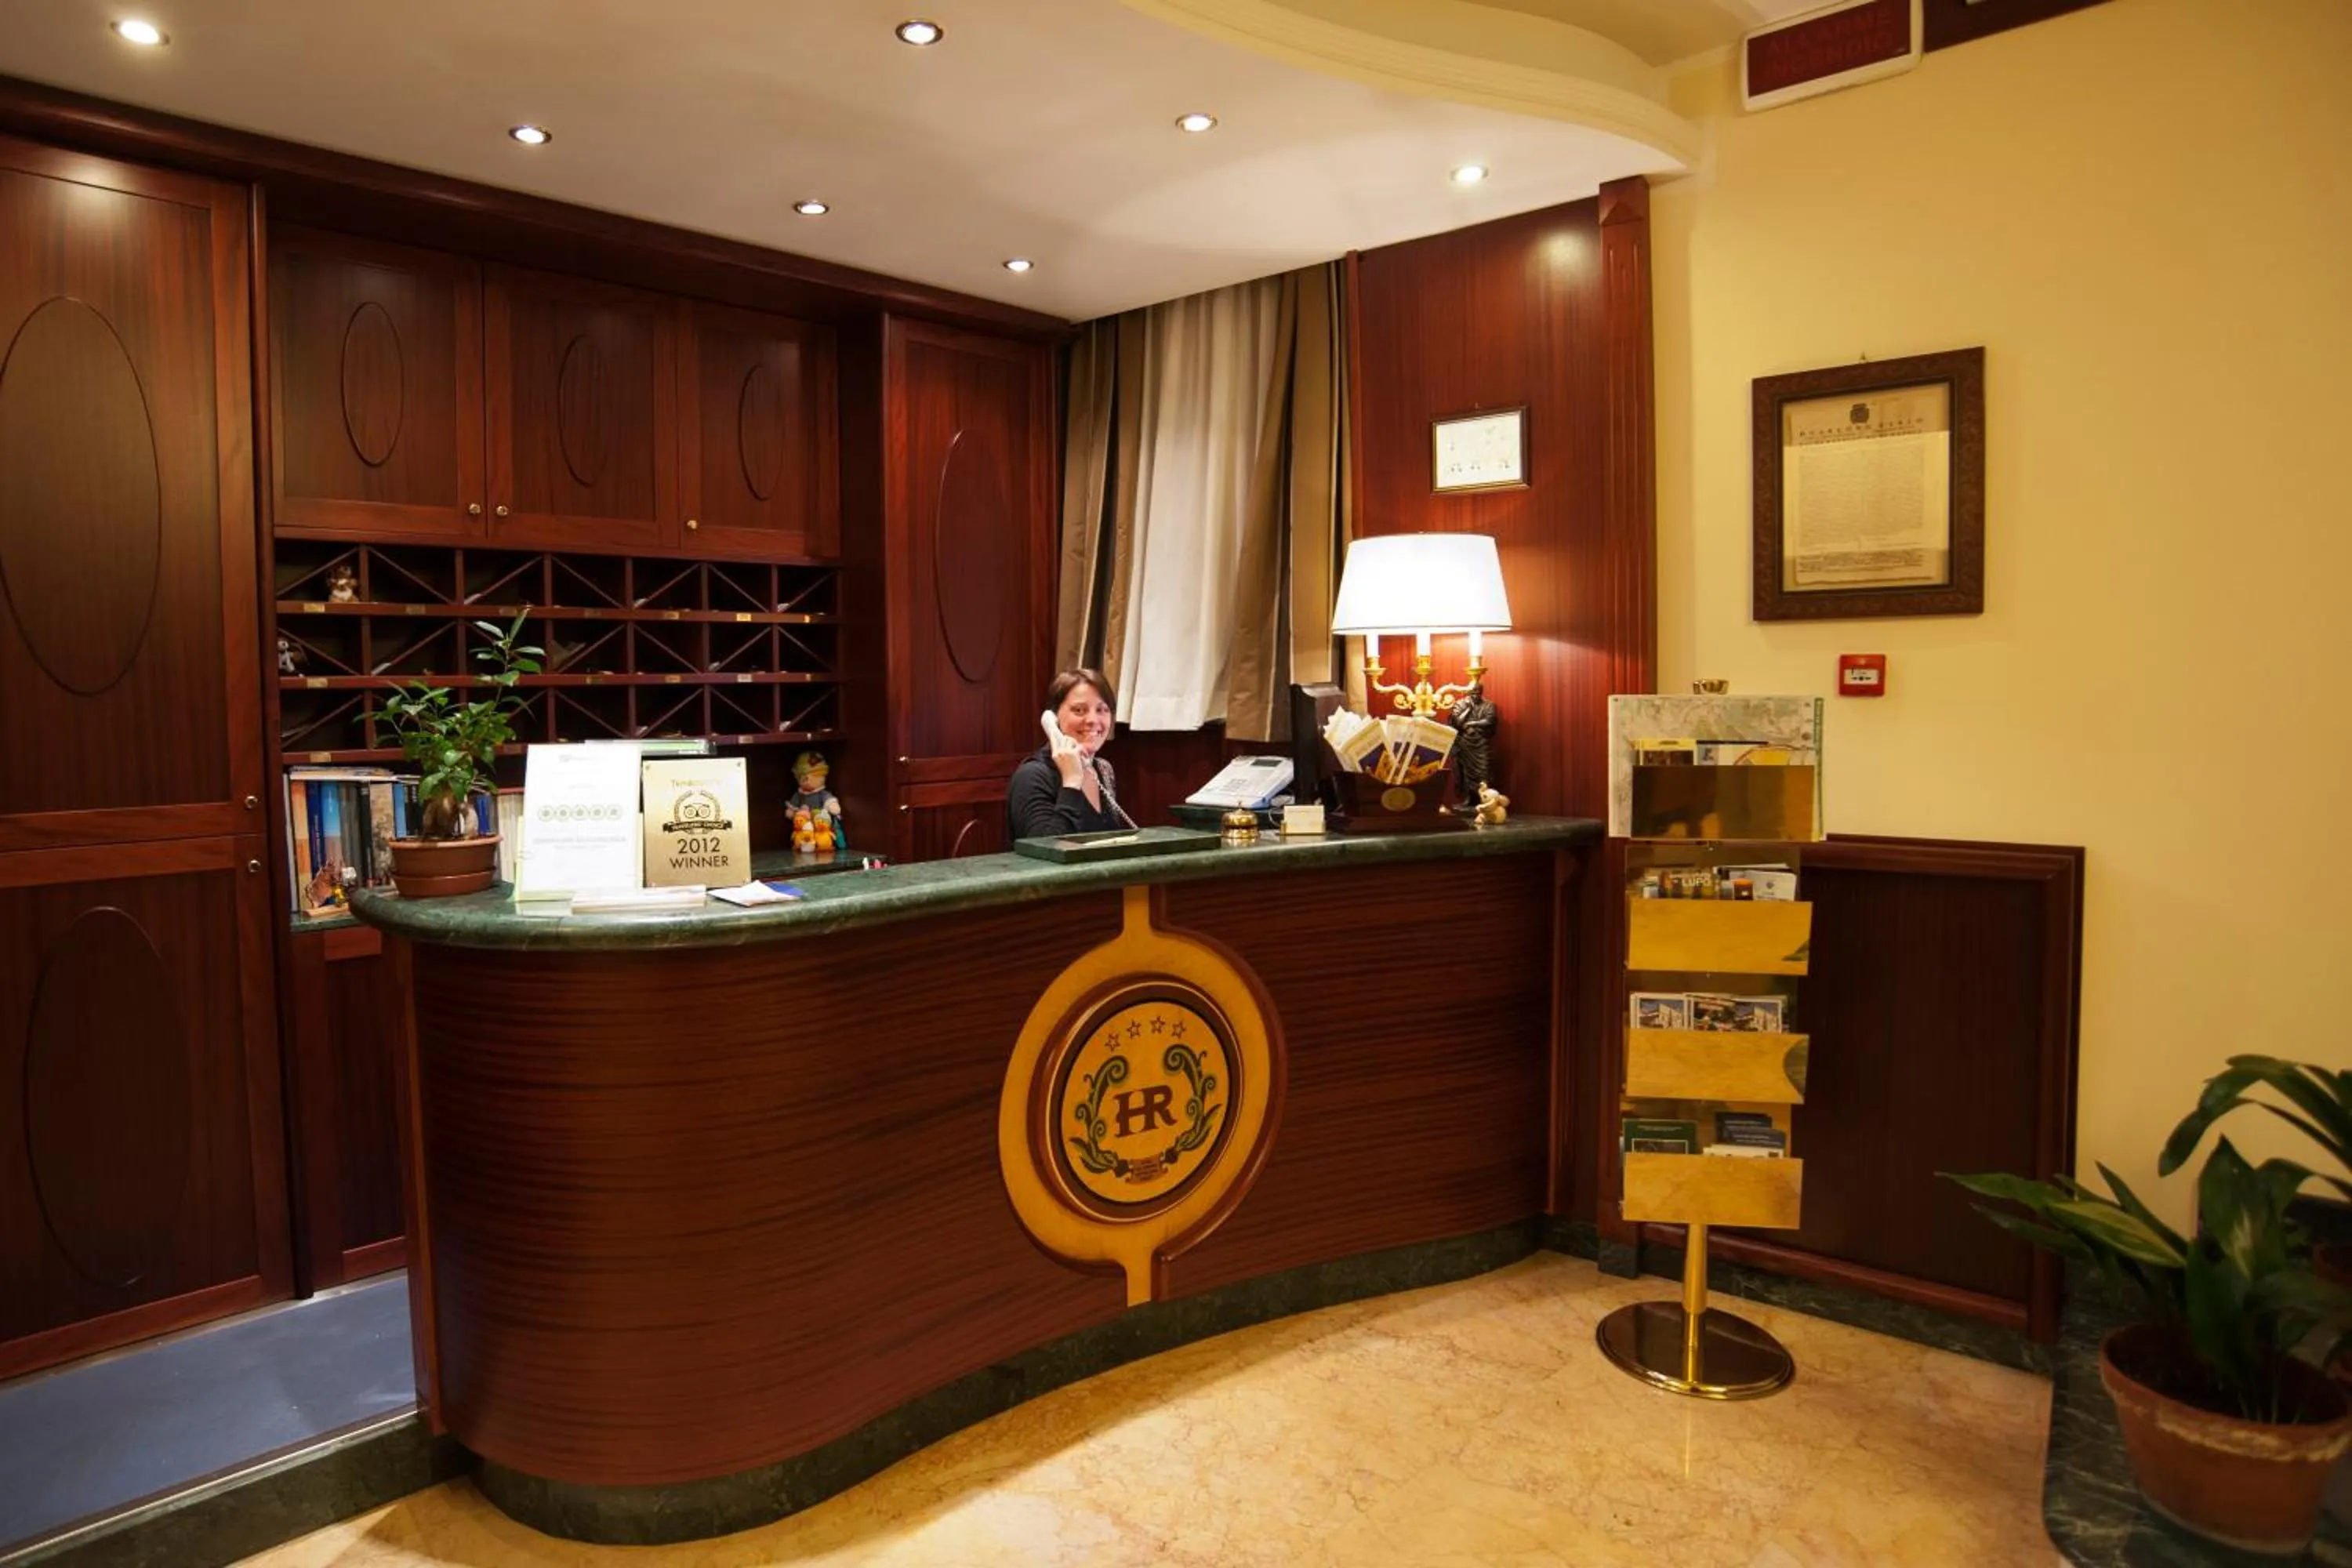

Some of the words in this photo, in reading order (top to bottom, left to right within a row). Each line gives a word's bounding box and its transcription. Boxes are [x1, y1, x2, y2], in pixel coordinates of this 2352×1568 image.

[677, 837, 720, 854] 2012
[670, 855, 729, 869] WINNER
[1113, 1084, 1178, 1138] HR
